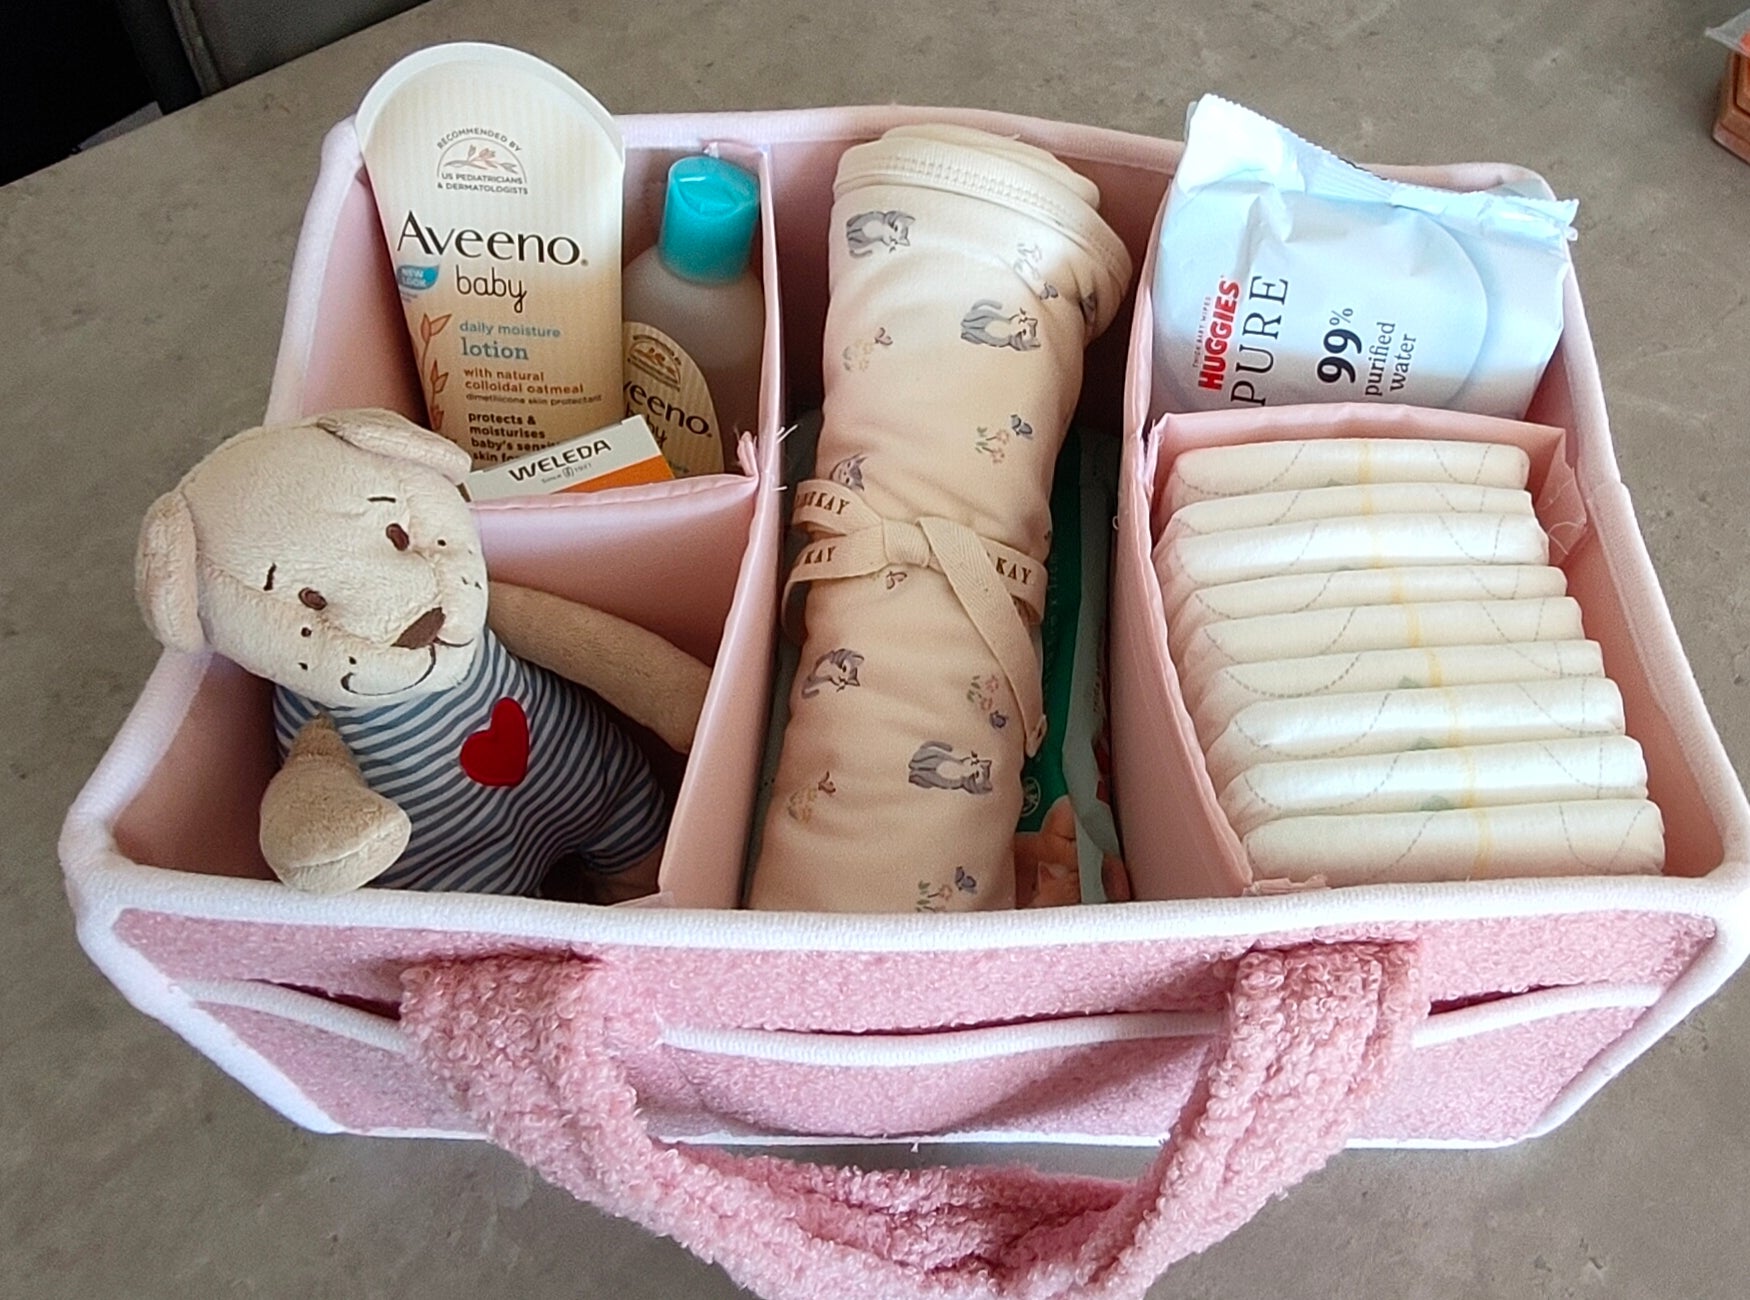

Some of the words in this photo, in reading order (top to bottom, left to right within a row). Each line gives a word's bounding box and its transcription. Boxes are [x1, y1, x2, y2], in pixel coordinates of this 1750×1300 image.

[437, 127, 508, 150] RECOMMENDED
[508, 140, 522, 152] BY
[441, 172, 454, 180] US
[455, 173, 523, 185] PEDIATRICIANS
[445, 182, 528, 195] DERMATOLOGISTS
[397, 210, 581, 266] Aveeno
[455, 264, 527, 314] baby
[459, 320, 494, 336] daily
[498, 323, 561, 338] moisture
[1198, 280, 1240, 391] HUGGIES
[460, 336, 529, 361] lotion
[1230, 275, 1289, 407] PURE
[1364, 321, 1396, 396] purified
[1389, 333, 1417, 392] water
[464, 367, 493, 378] with
[496, 370, 544, 382] natural
[465, 379, 522, 393] colloidal
[526, 383, 584, 395] oatmeal
[468, 412, 523, 426] protects
[527, 415, 537, 425] &
[469, 426, 546, 439] moisturises
[471, 437, 513, 452] baby's
[473, 449, 498, 462] skin
[507, 439, 612, 482] WELEDA
